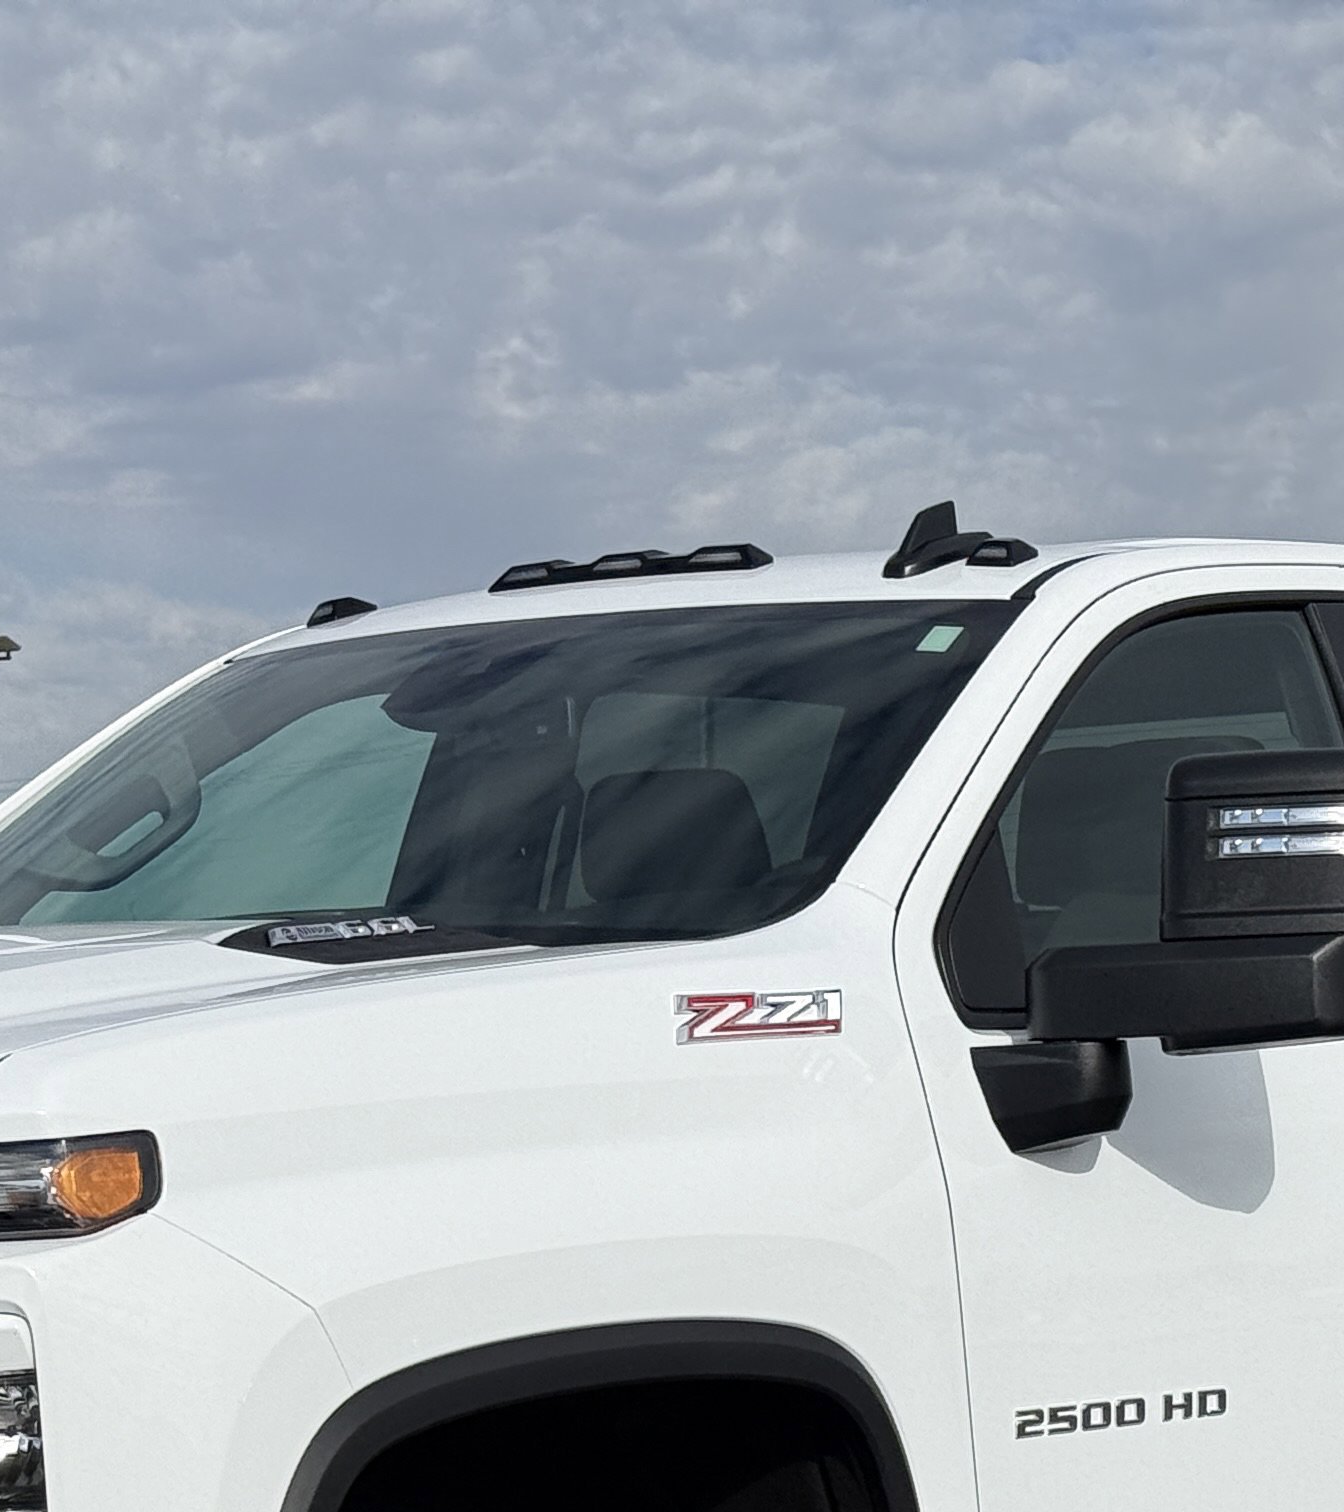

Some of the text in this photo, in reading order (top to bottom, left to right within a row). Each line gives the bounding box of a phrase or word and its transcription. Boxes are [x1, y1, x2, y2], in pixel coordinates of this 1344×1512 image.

[673, 988, 843, 1046] Z71
[1014, 1388, 1227, 1440] 2500 HD
